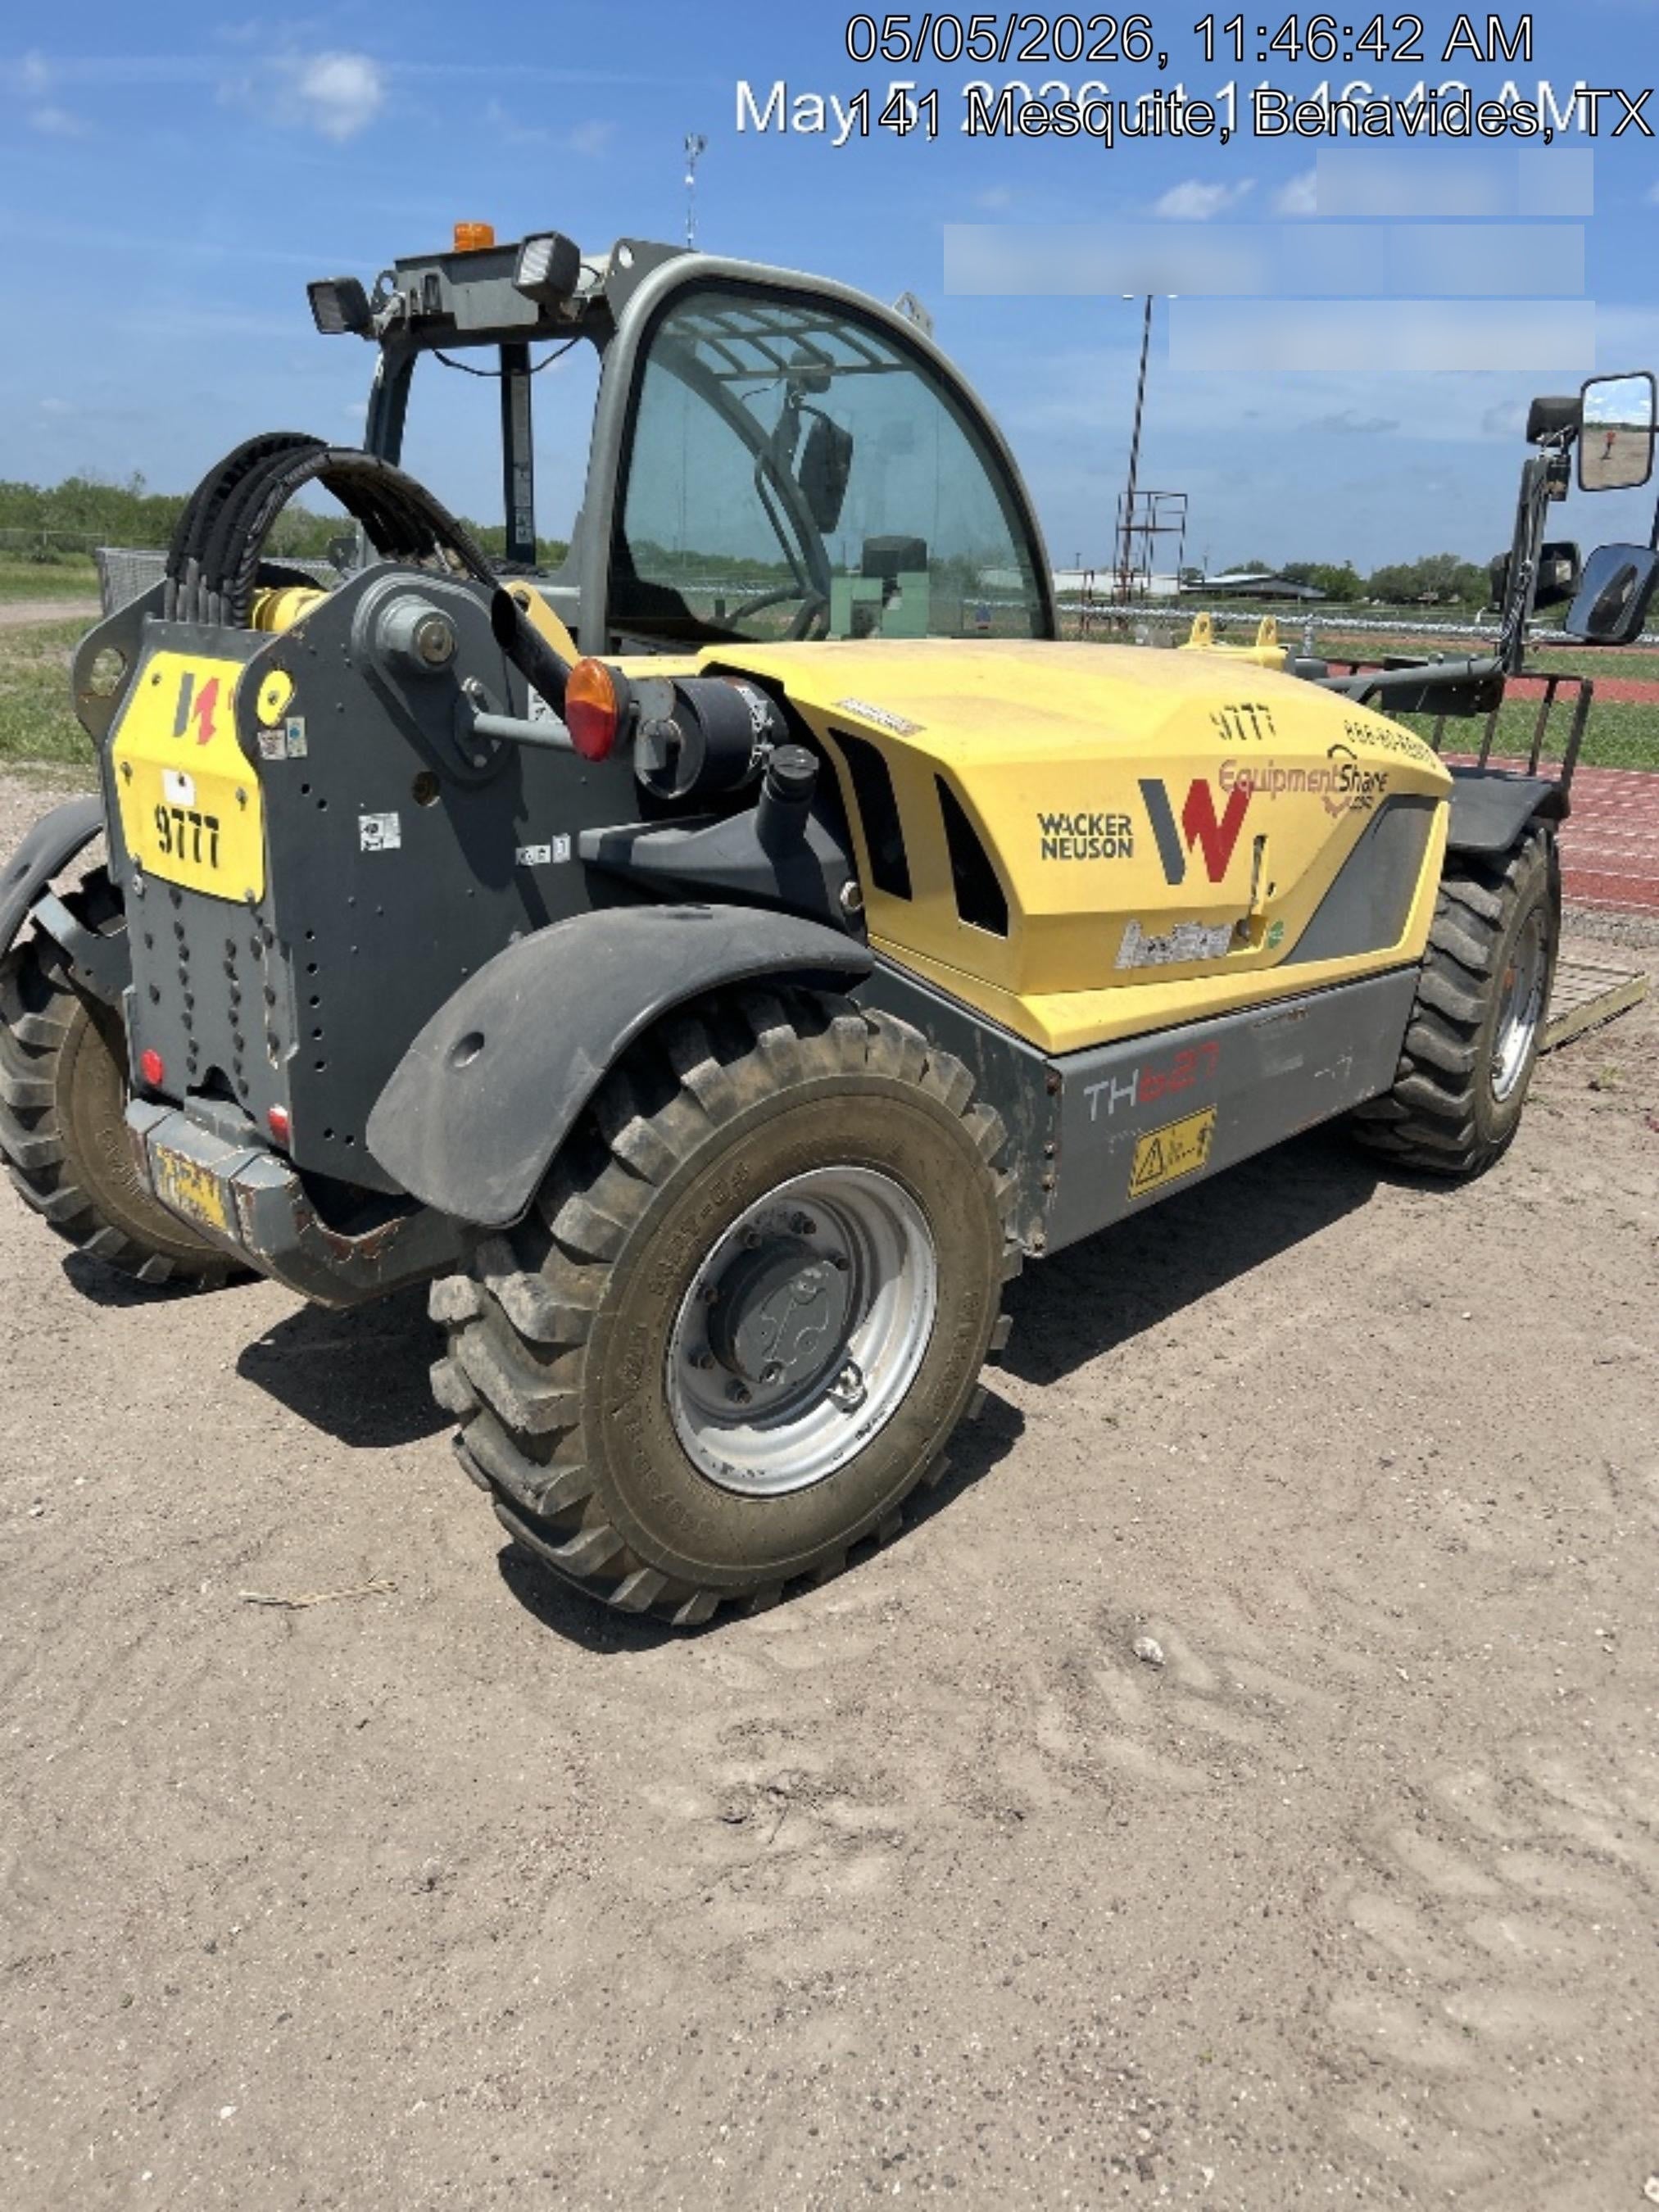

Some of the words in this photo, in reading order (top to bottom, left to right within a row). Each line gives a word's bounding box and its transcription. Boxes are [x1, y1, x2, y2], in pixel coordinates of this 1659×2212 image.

[1208, 702, 1276, 741] 9777
[1218, 757, 1389, 802] EquipmentShare
[154, 803, 220, 869] 9777
[1036, 812, 1133, 836] WACKER
[1040, 836, 1135, 860] NEUSON
[1083, 1040, 1221, 1122] TH627
